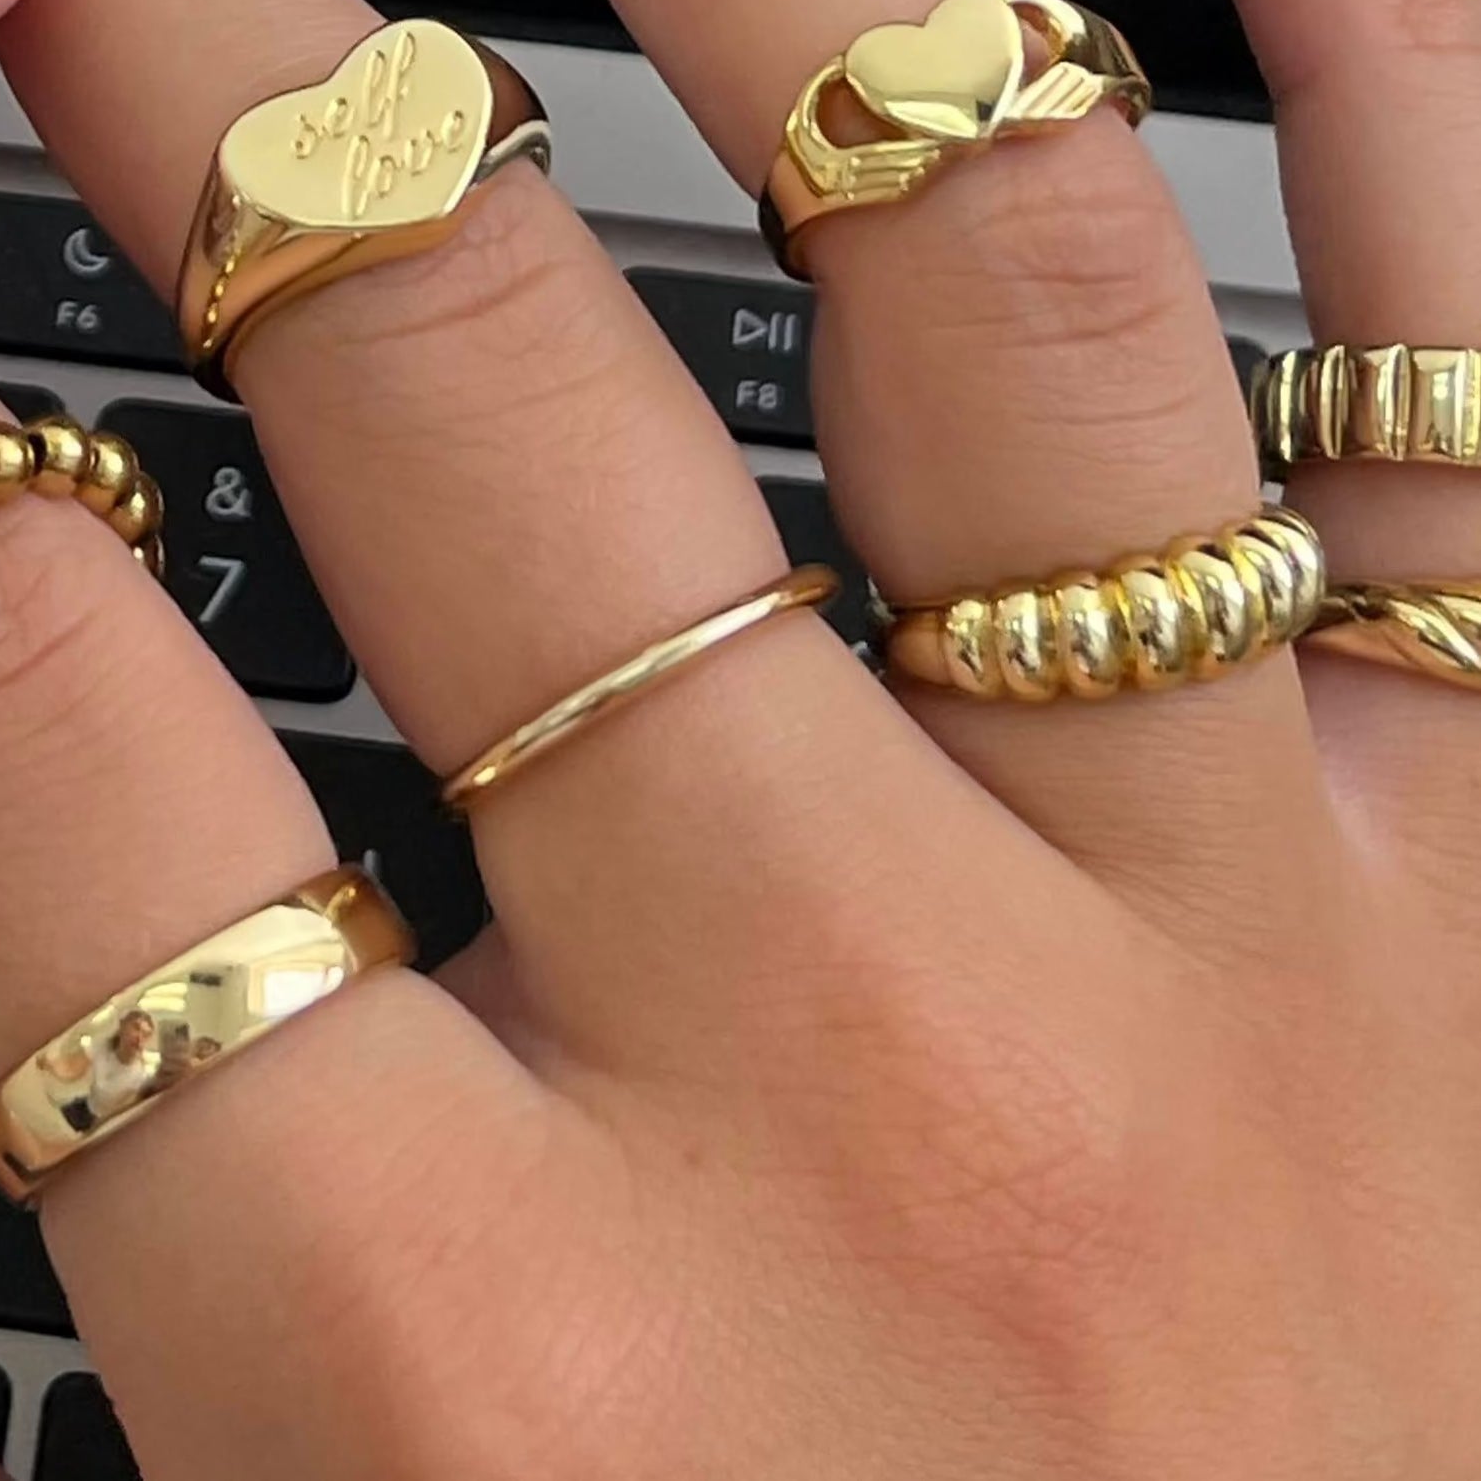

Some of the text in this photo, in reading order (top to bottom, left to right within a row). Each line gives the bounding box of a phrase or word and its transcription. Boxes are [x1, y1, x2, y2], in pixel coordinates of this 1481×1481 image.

[290, 28, 417, 160] self
[340, 108, 466, 219] love
[55, 299, 101, 335] F6
[735, 379, 778, 410] F8
[205, 466, 253, 518] &
[198, 554, 245, 622] 7
